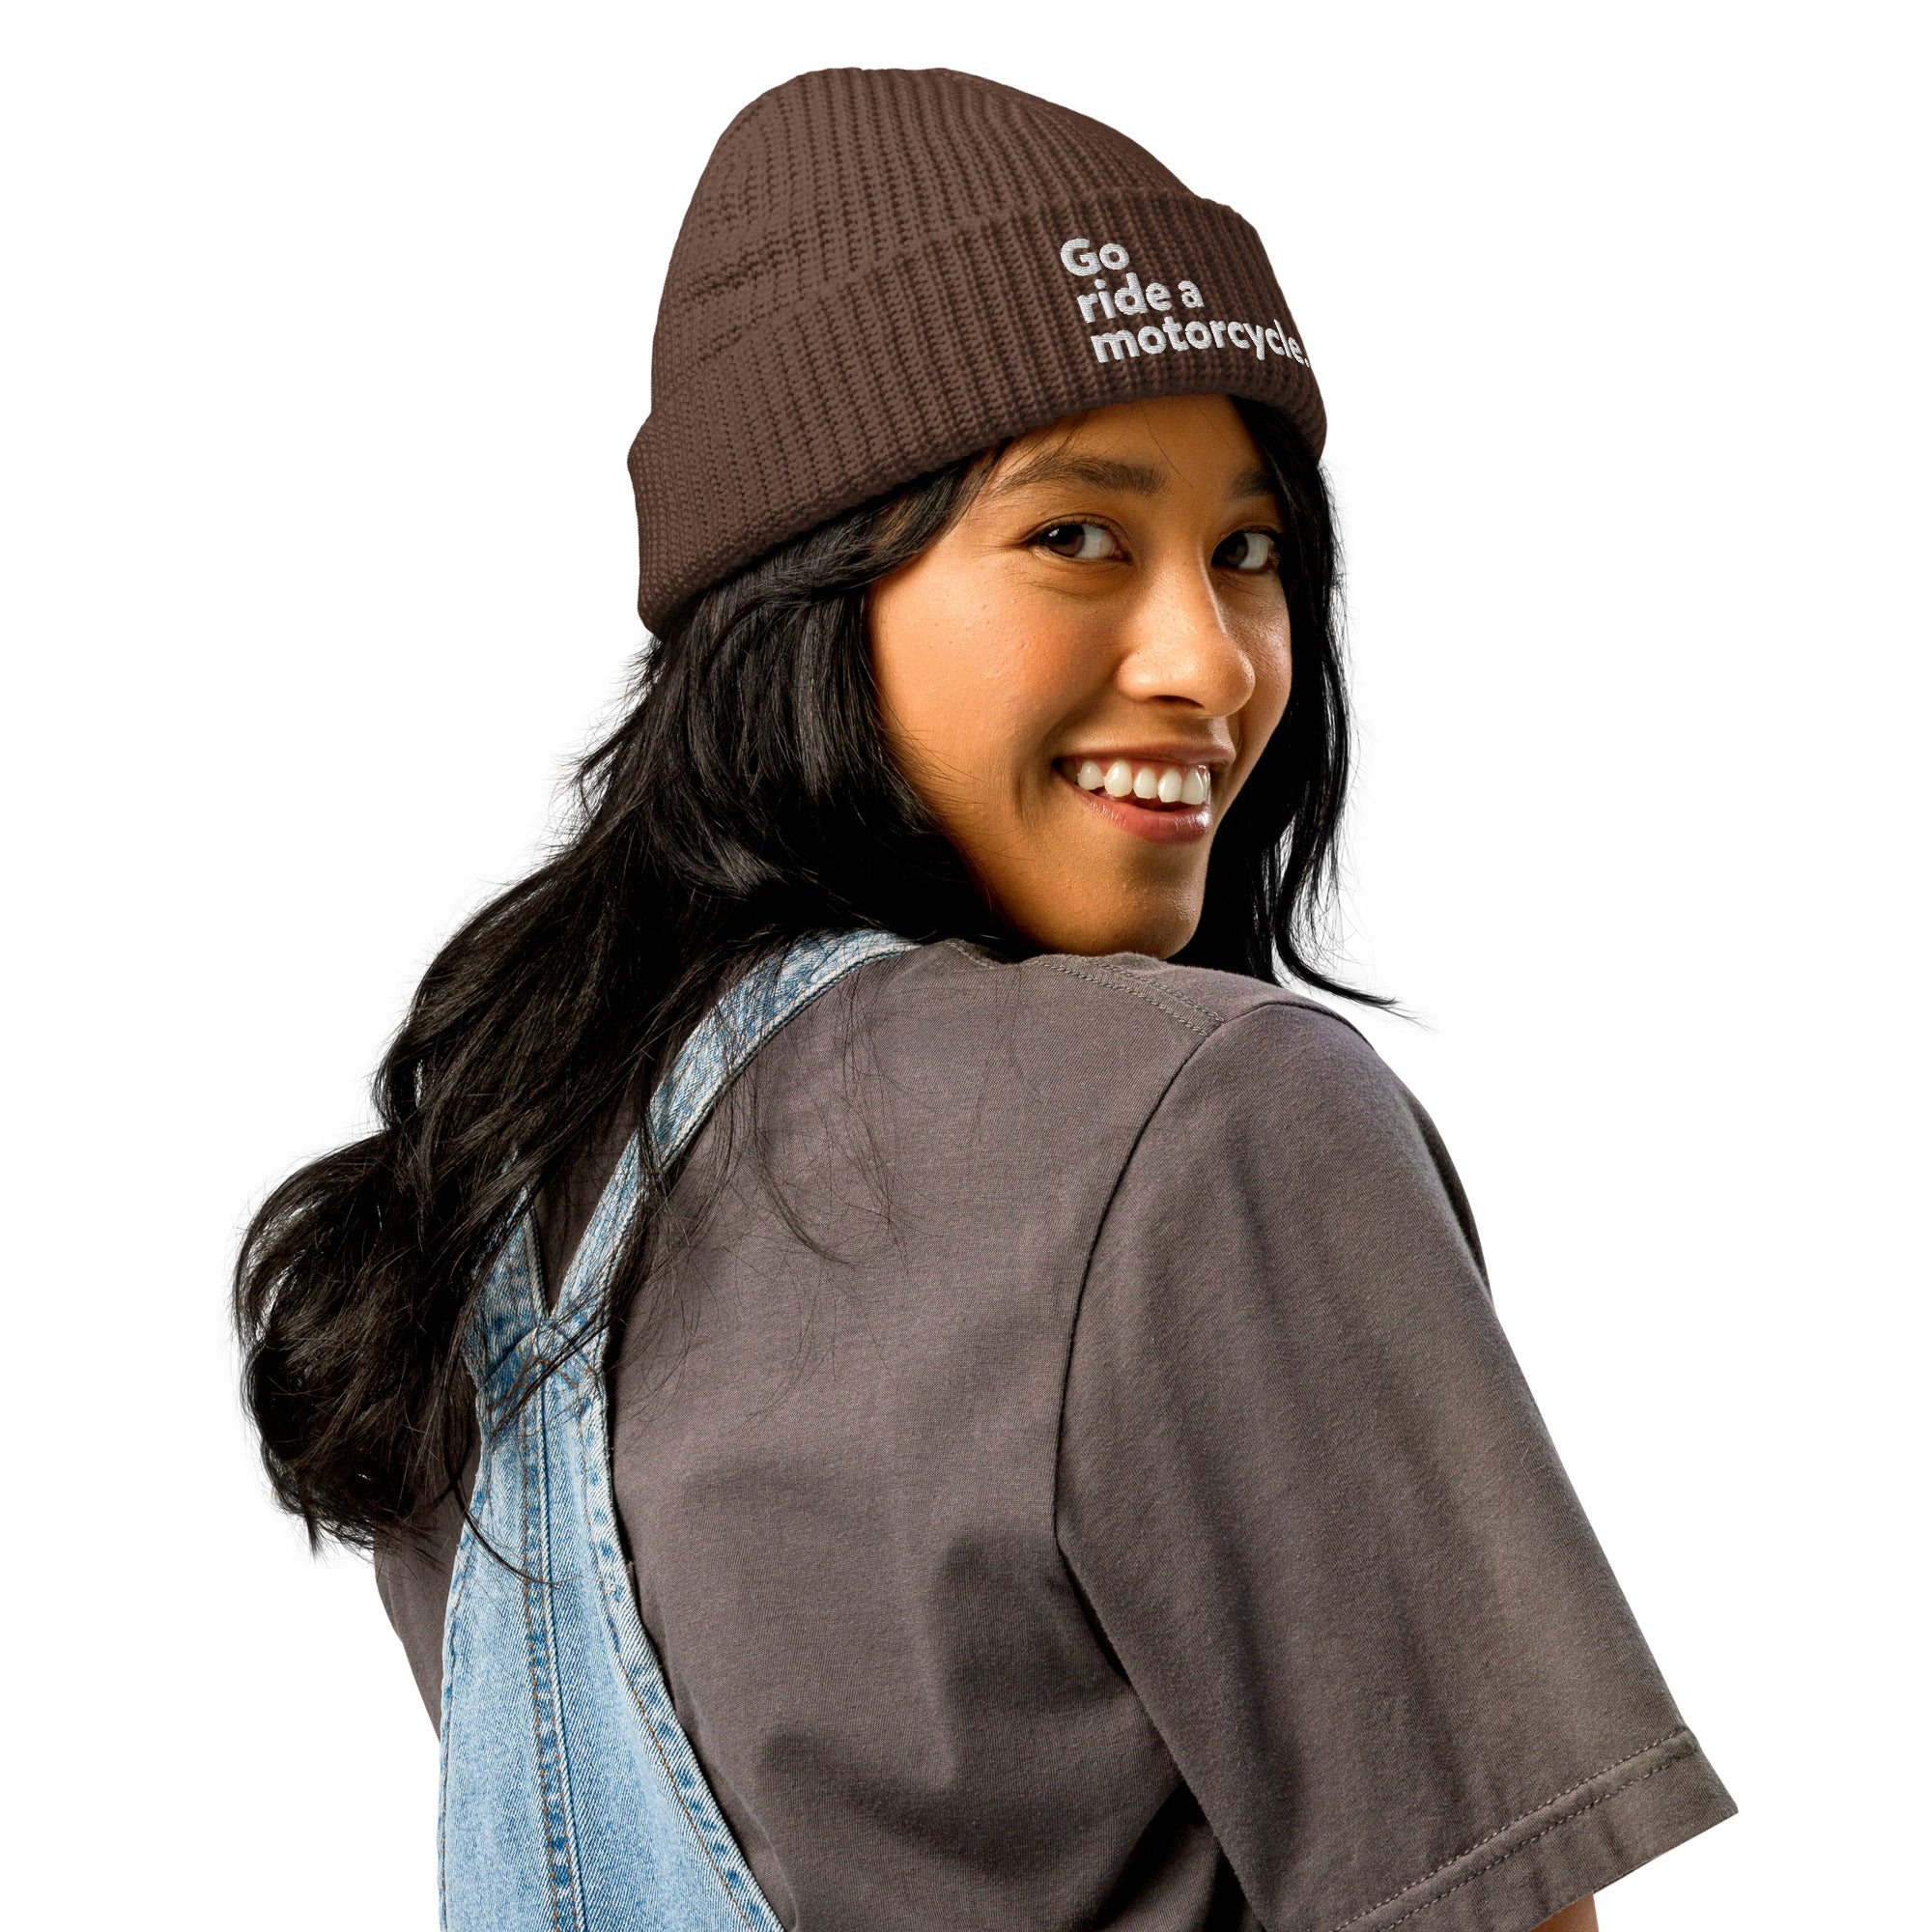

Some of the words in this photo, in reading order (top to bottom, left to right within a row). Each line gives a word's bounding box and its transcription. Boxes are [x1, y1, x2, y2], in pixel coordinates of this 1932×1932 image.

[1060, 238, 1130, 277] Go
[1076, 271, 1173, 324] ride
[1177, 280, 1206, 309] a
[1090, 316, 1310, 368] motorcycle.
